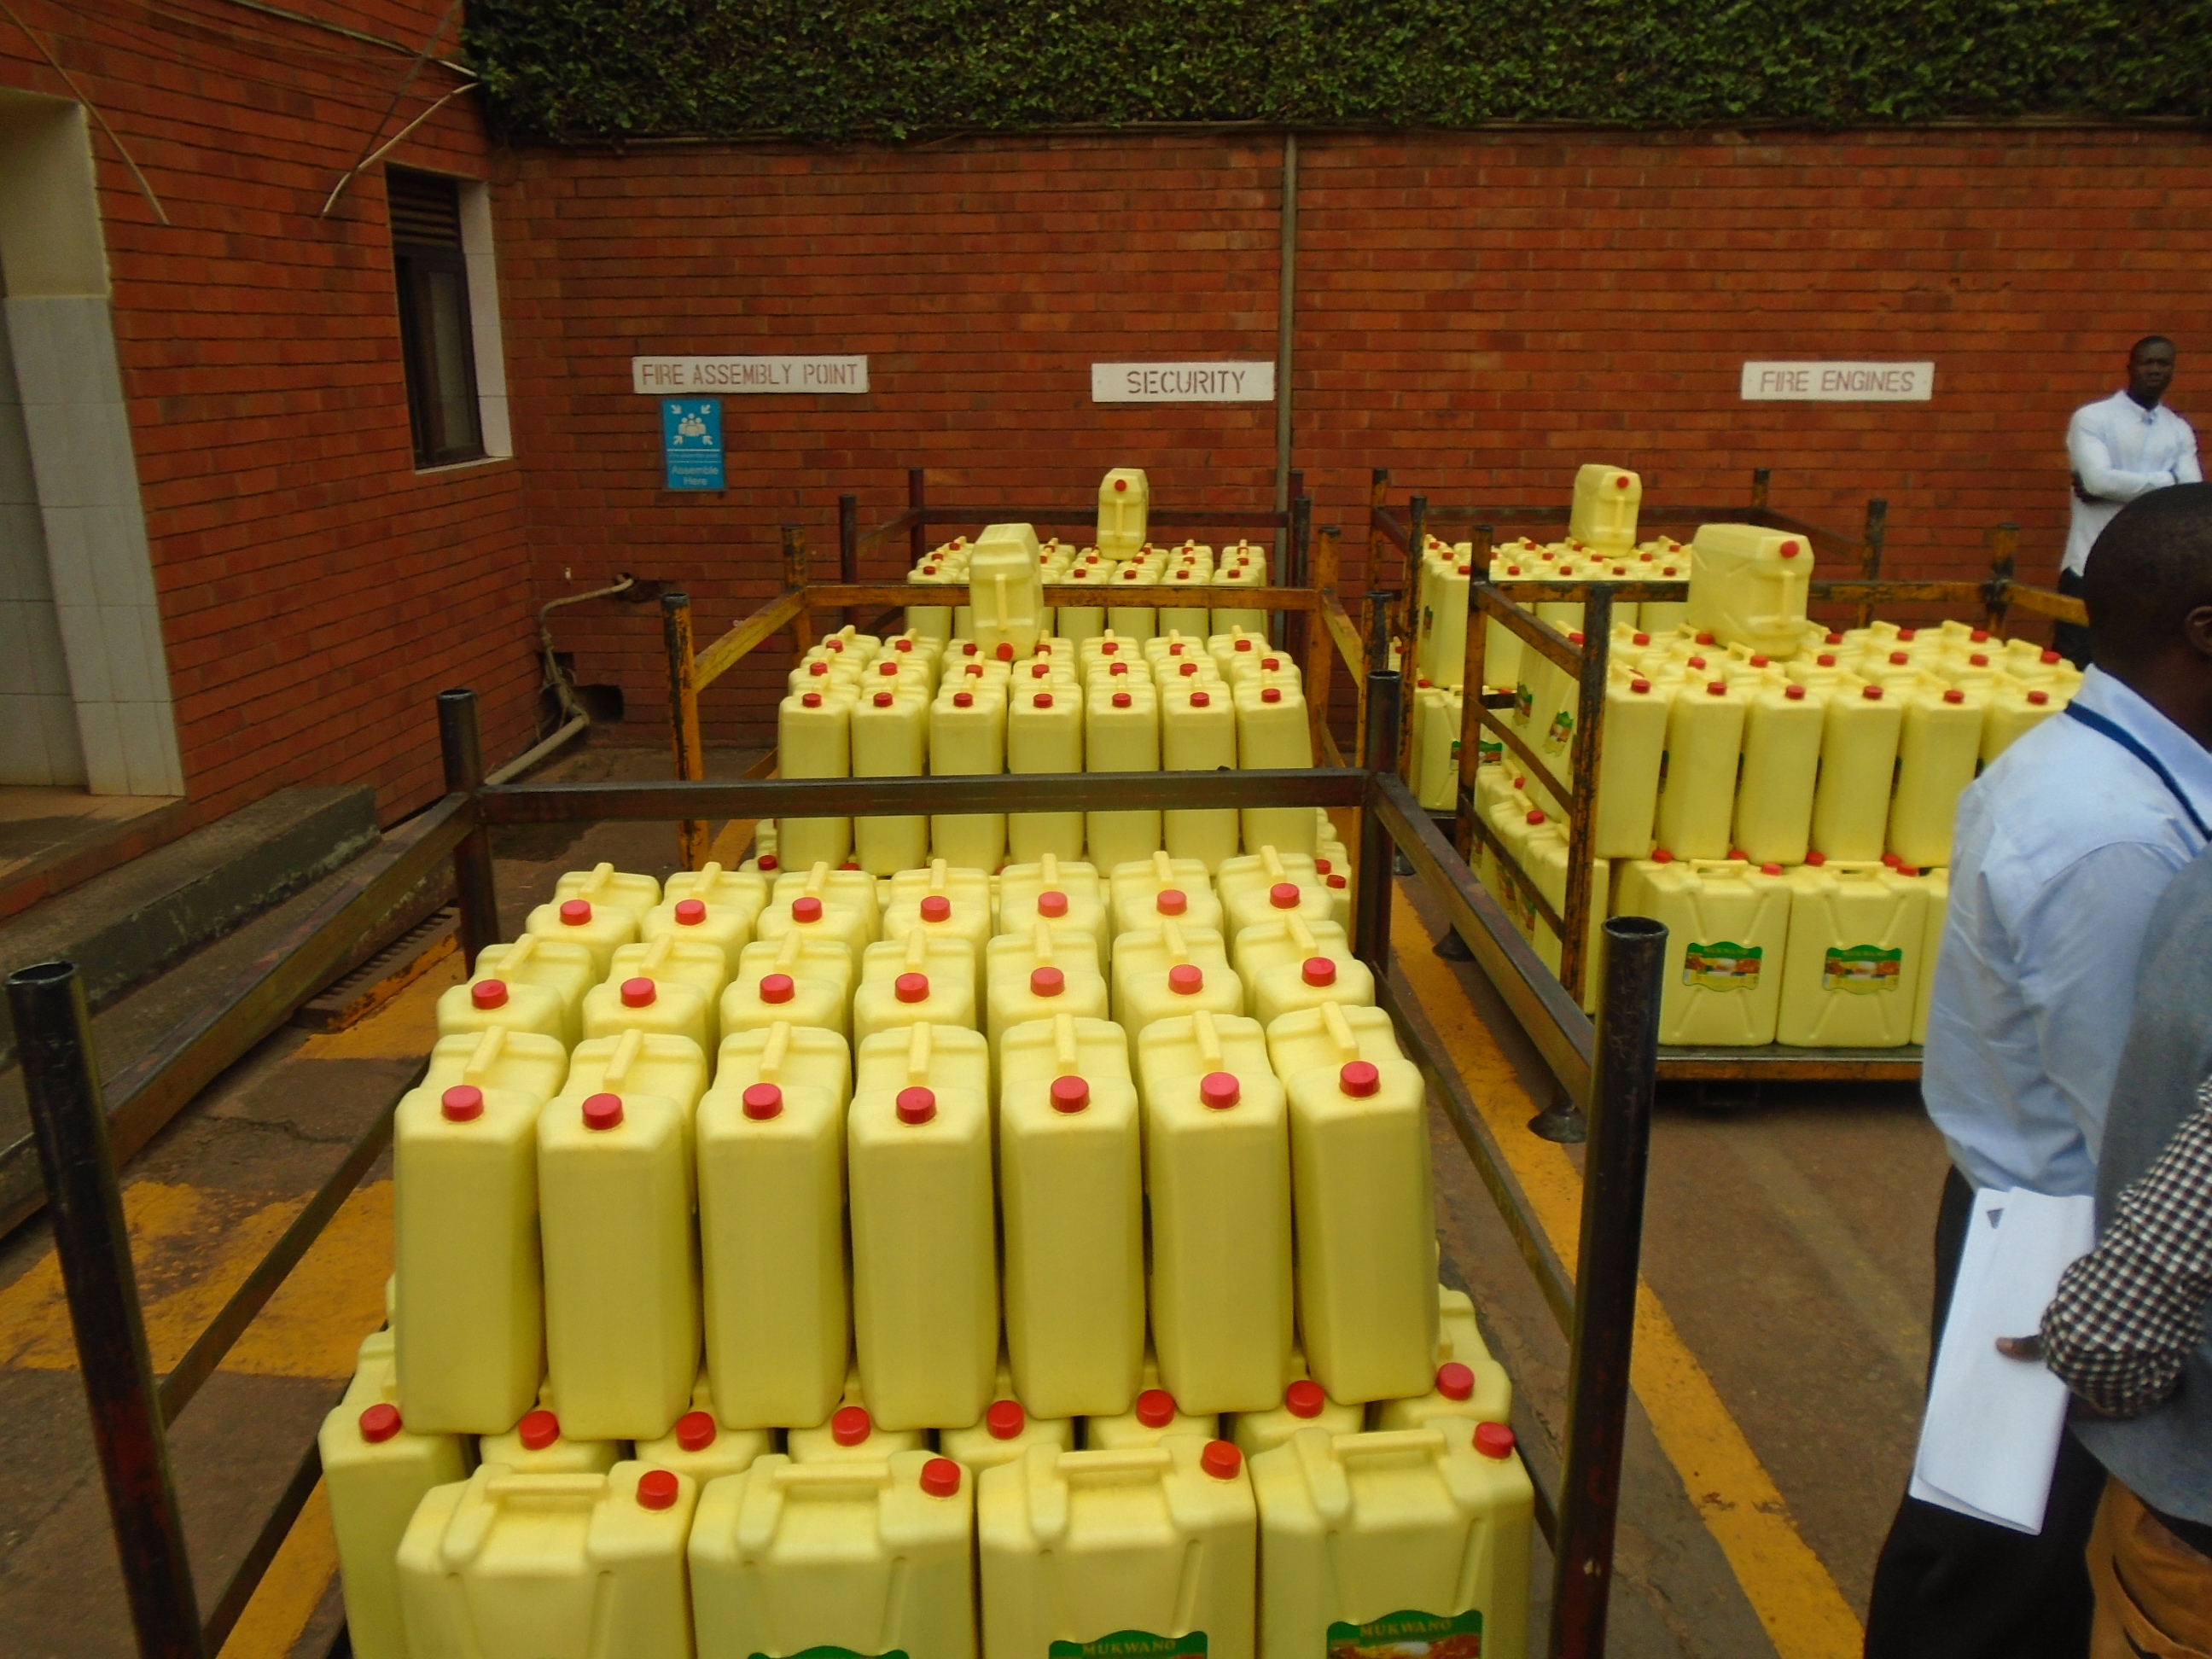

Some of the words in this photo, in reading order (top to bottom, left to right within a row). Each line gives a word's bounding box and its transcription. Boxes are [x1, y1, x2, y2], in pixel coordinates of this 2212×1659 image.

[642, 364, 683, 385] FIRE
[693, 364, 792, 385] ASSEMBLY
[803, 363, 858, 385] POINT
[1126, 370, 1246, 394] SECURITY
[1760, 370, 1809, 393] FIRE
[1821, 370, 1915, 393] ENGINES
[1082, 1639, 1177, 1656] MUKWANO
